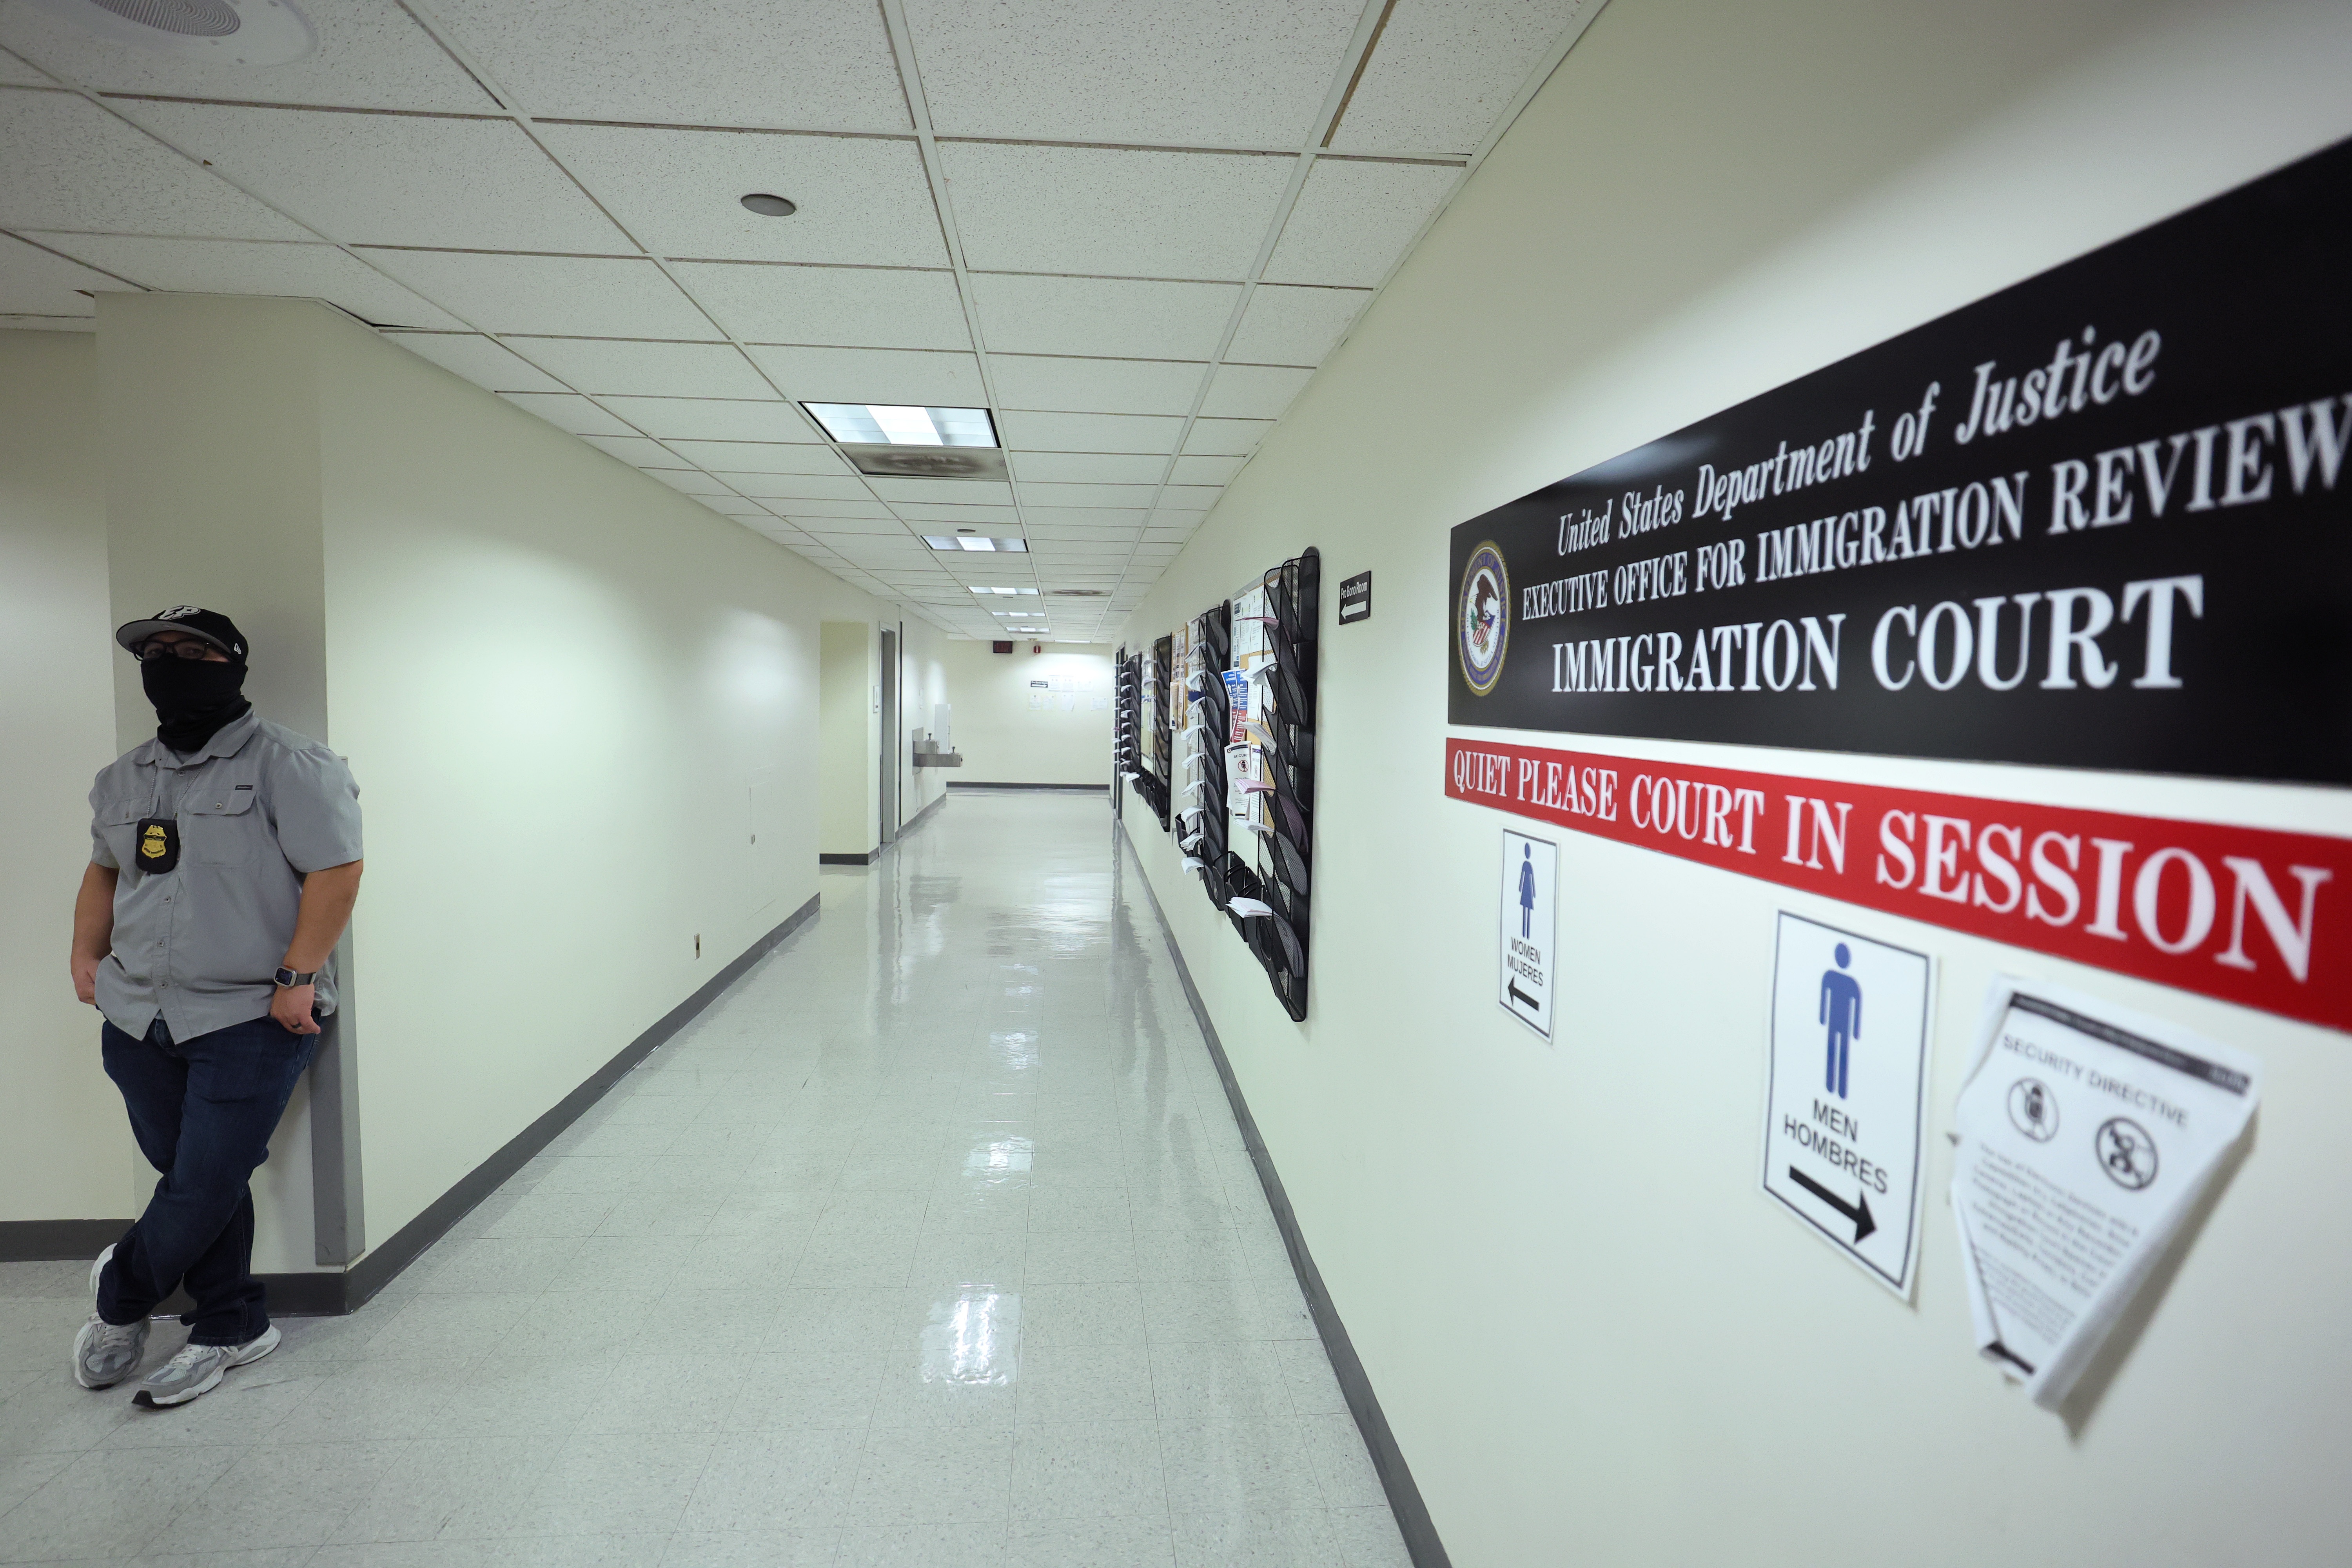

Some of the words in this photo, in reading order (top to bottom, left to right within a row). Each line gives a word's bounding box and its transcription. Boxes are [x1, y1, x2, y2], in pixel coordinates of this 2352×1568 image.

[1559, 508, 1610, 555] United
[1619, 490, 1684, 539] States
[1692, 410, 1874, 521] Department
[1891, 382, 1940, 461] of
[1956, 327, 2160, 443] Justice
[1523, 570, 1608, 620] EXECUTIVE
[1614, 551, 1687, 605] OFFICE
[1696, 539, 1745, 592] FOR
[1757, 472, 2027, 582] IMMIGRATION
[2049, 396, 2351, 534] REVIEW
[1347, 585, 1356, 597] Bono
[1356, 581, 1368, 594] Room
[1552, 614, 1846, 692] IMMIGRATION
[1872, 577, 2202, 691] COURT
[1454, 750, 1510, 797] QUIET
[1517, 759, 1617, 821] PLEASE
[1630, 775, 1764, 853] COURT
[1783, 795, 1852, 873] IN
[1877, 809, 2328, 979] SESSION
[1508, 955, 1543, 986] MUJERES
[1512, 938, 1541, 964] WOMEN
[1814, 1100, 1857, 1142] MEN
[2003, 1034, 2085, 1081] SECURITY
[2087, 1070, 2189, 1127] DIRECTIVE
[1785, 1115, 1887, 1194] HOMBRES
